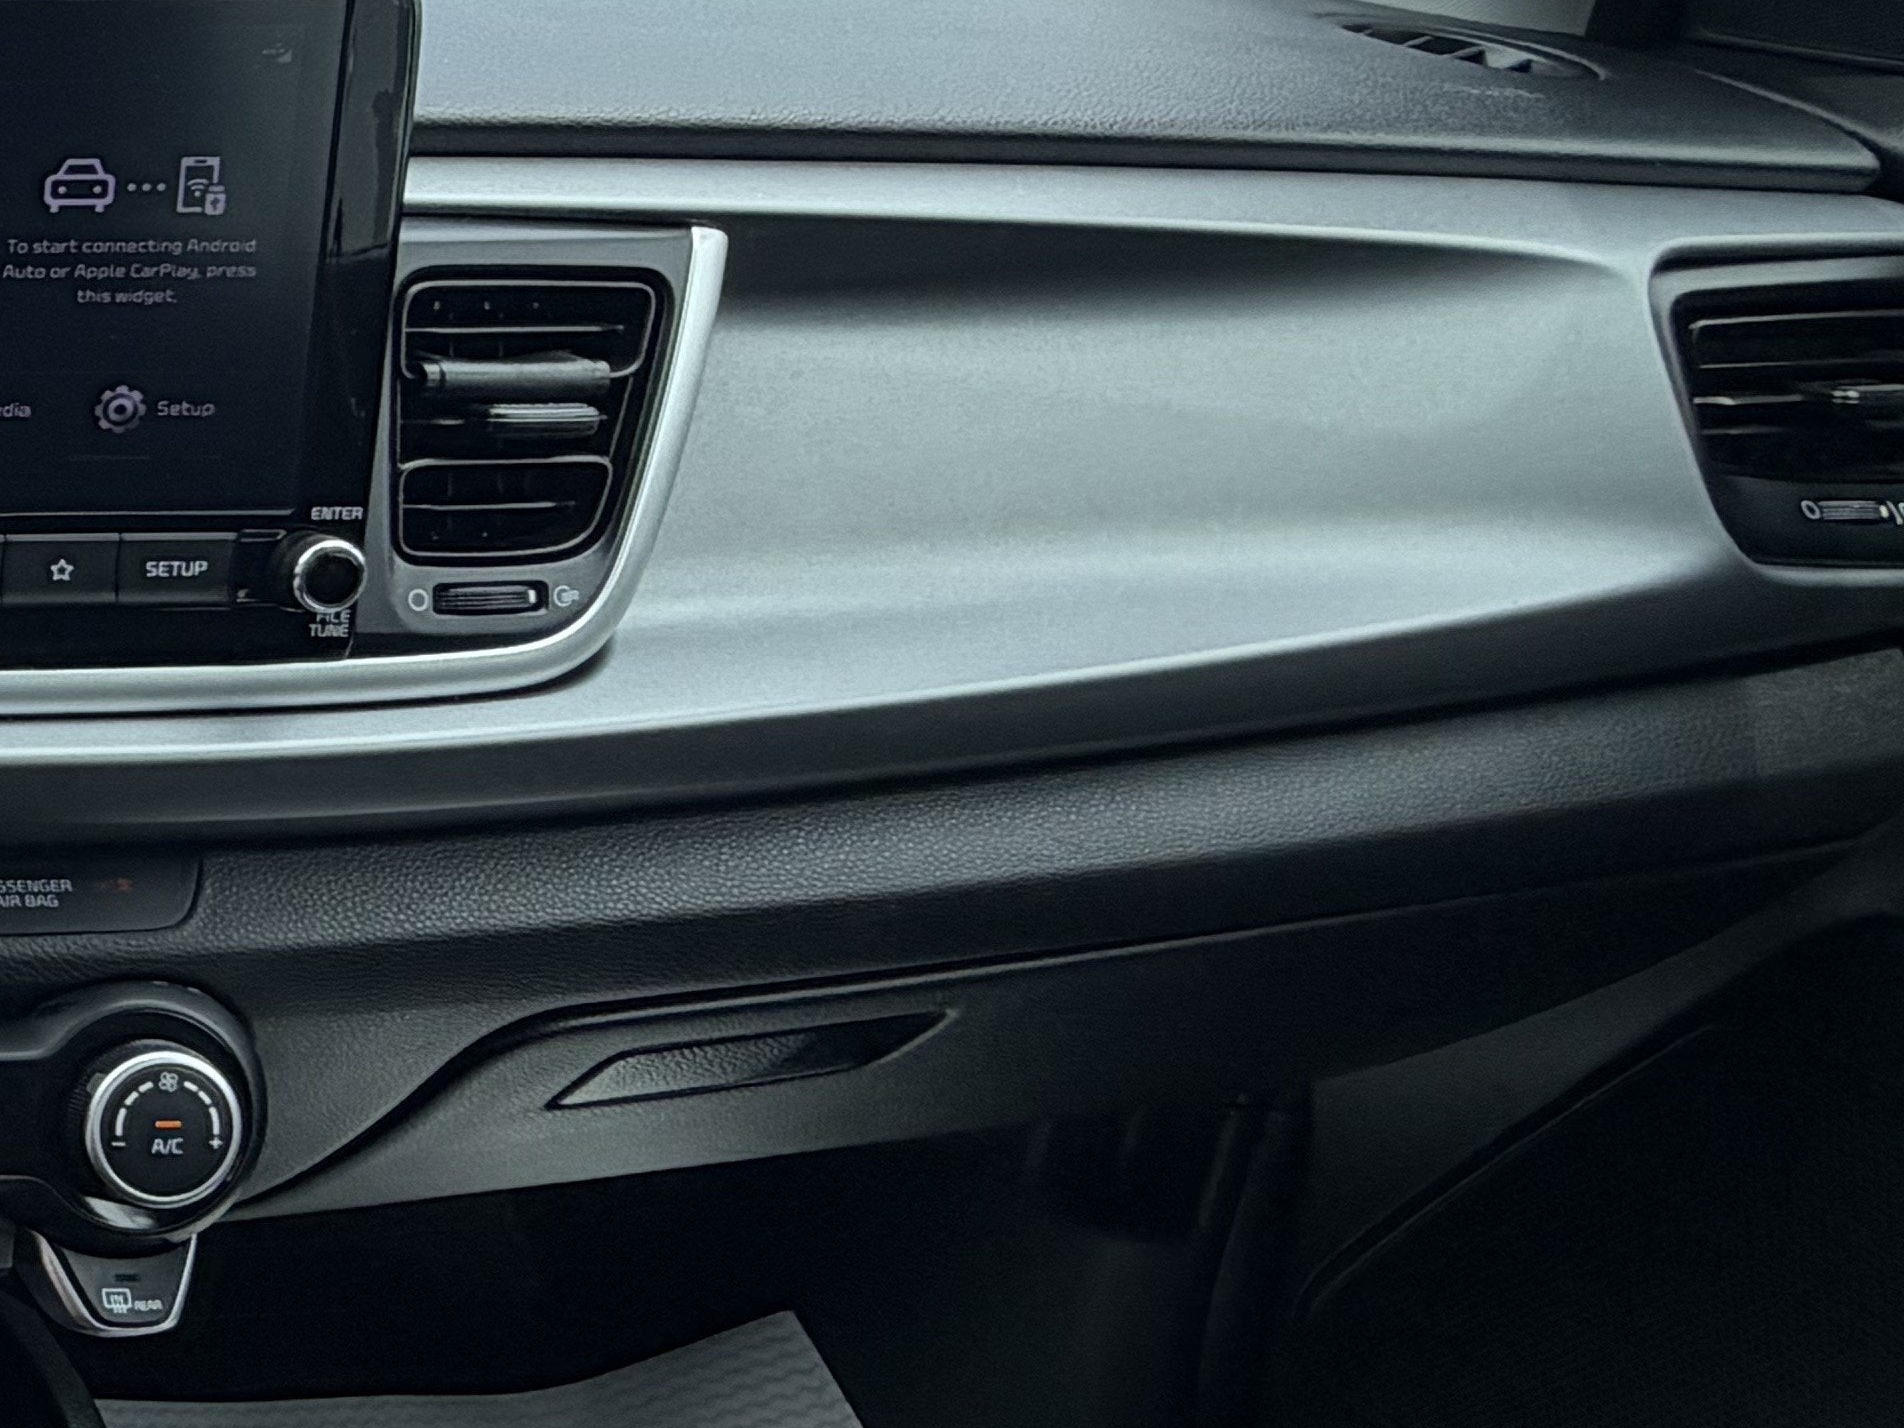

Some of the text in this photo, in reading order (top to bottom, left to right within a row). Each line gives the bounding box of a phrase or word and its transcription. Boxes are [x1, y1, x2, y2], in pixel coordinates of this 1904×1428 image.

[7, 238, 257, 256] To start connecting Android
[2, 263, 46, 279] Auto
[49, 265, 71, 279] or
[73, 263, 127, 281] Apple
[206, 264, 257, 280] press
[77, 289, 178, 306] this widget.
[156, 399, 216, 418] Setup
[311, 505, 364, 521] ENTER
[145, 559, 209, 578] SETUP
[308, 623, 350, 638] TUNE
[24, 894, 60, 908] BAG
[151, 1137, 185, 1156] A/C
